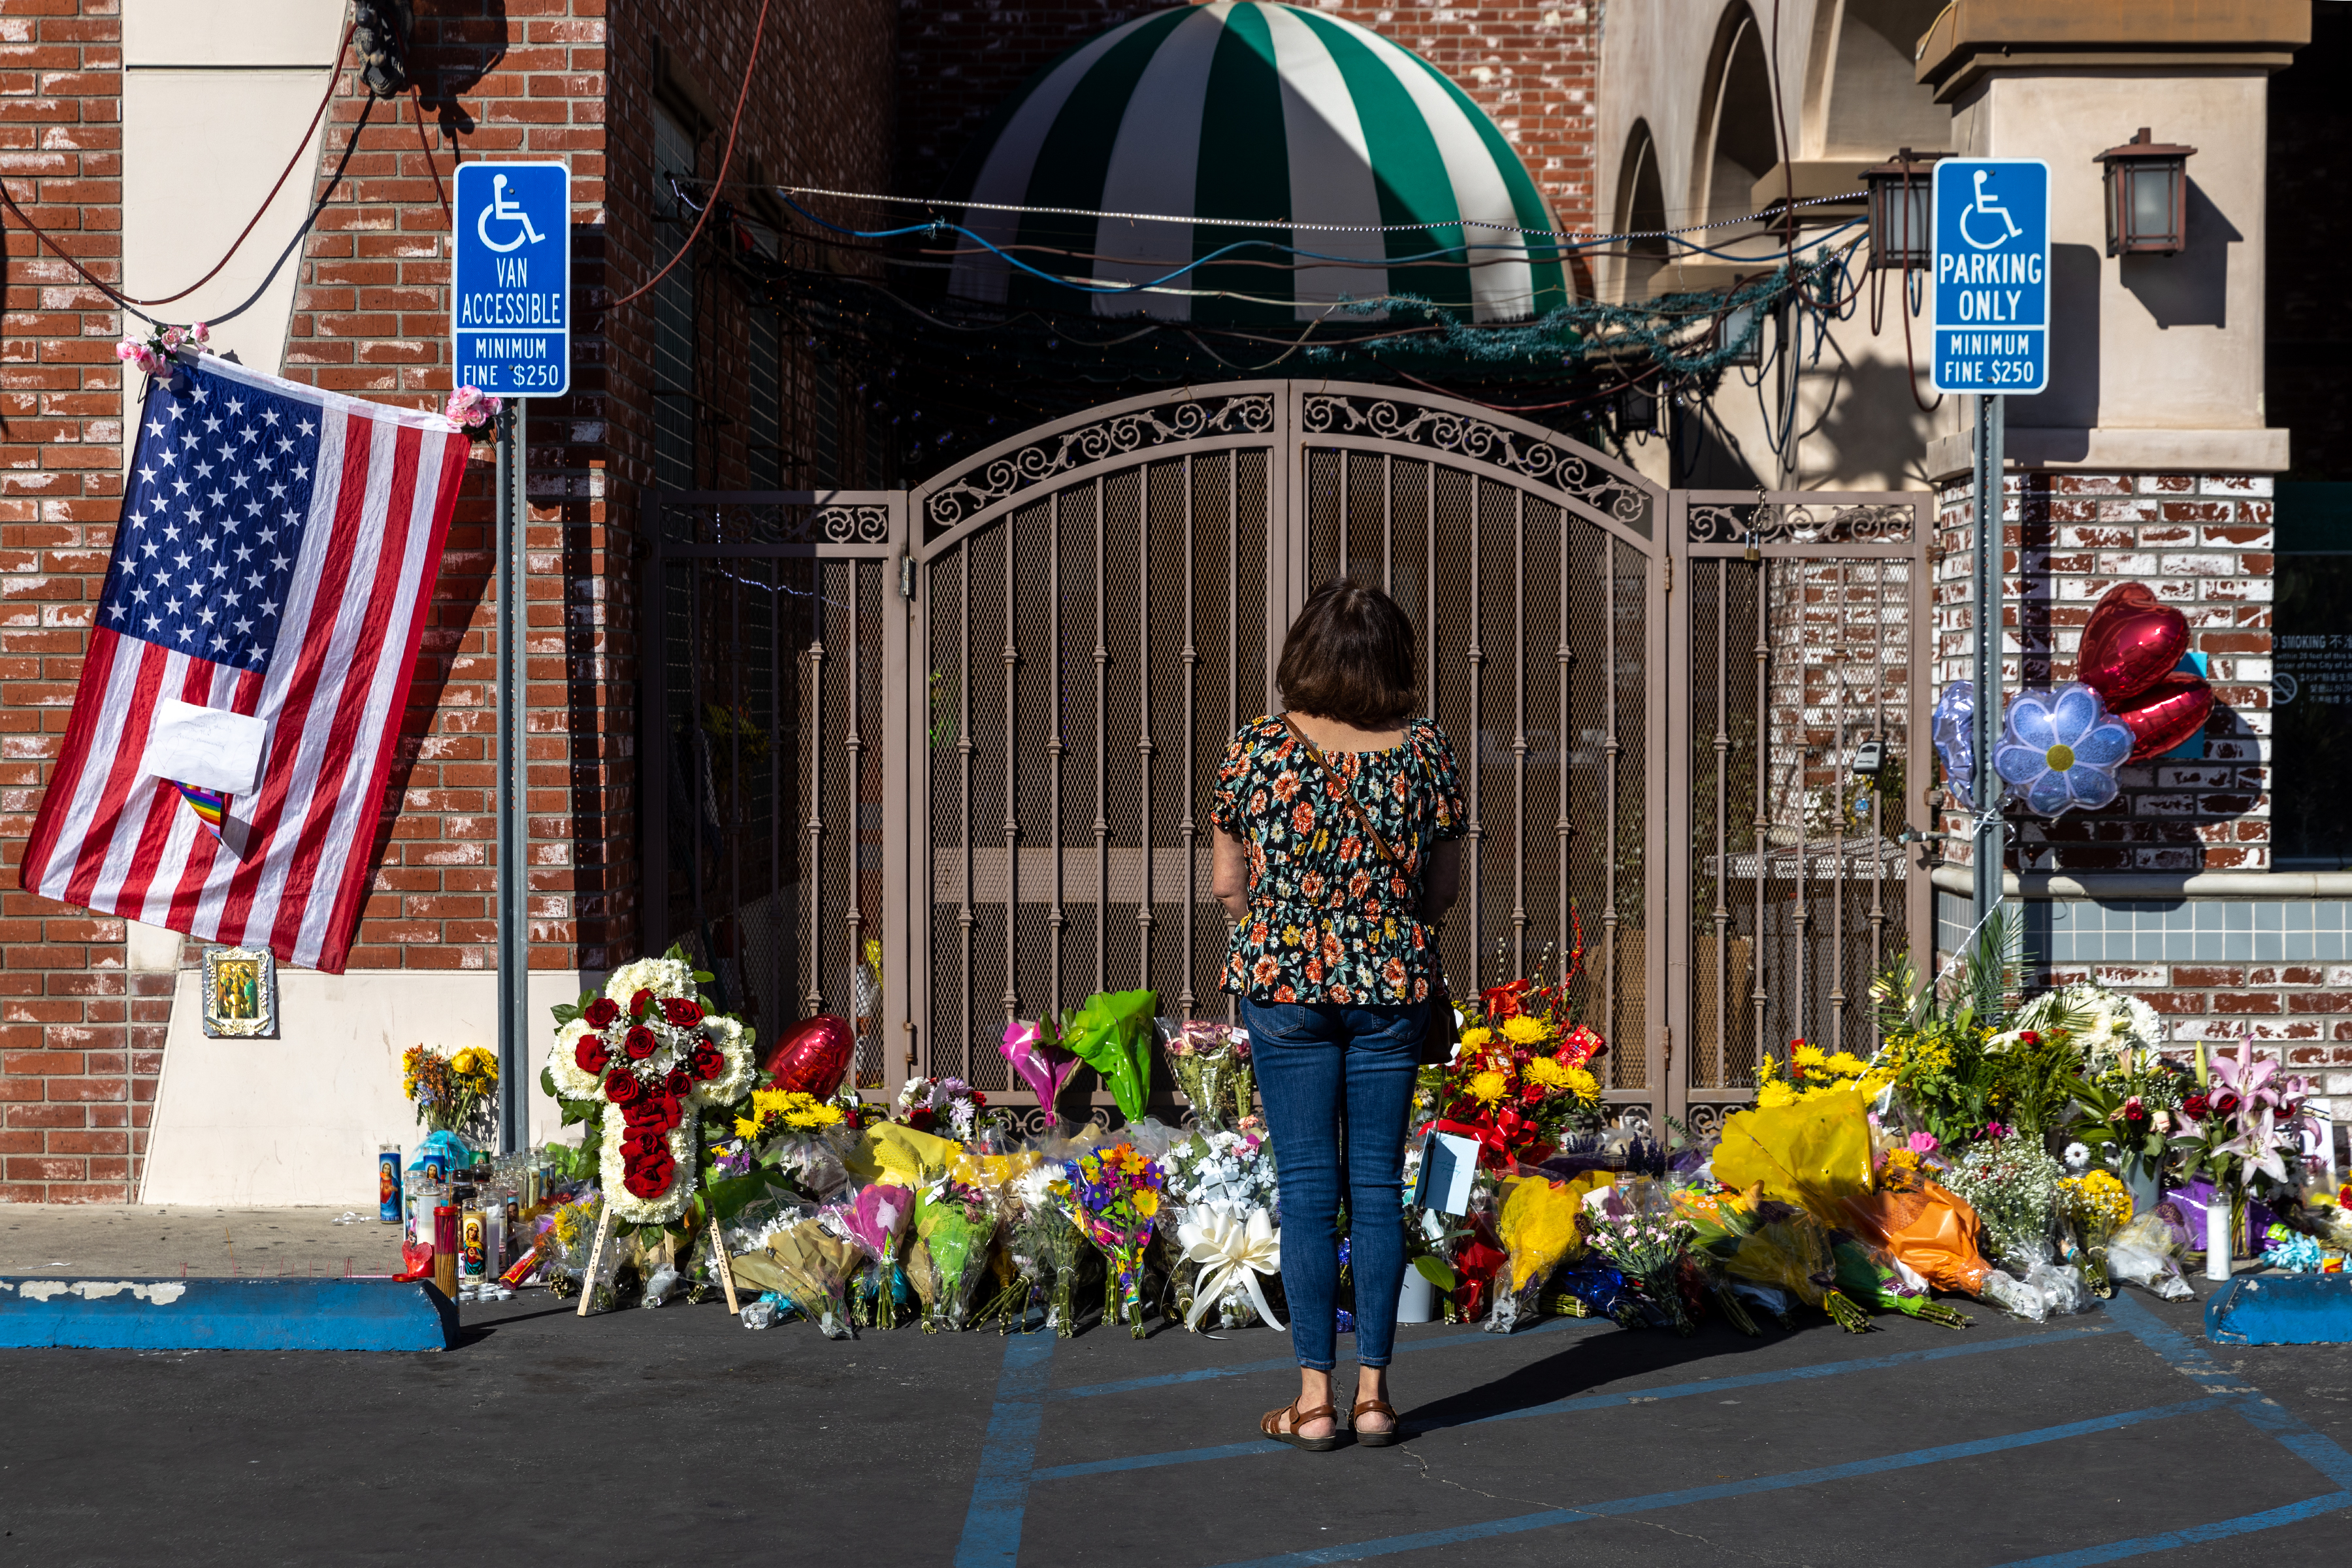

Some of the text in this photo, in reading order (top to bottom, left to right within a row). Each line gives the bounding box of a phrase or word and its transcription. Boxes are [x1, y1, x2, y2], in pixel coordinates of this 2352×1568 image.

[496, 257, 527, 288] VAN
[1940, 253, 2042, 284] PARKING
[462, 293, 561, 324] ACCESSIBLE
[1959, 290, 2022, 321] ONLY
[476, 338, 546, 359] MINIMUM
[1950, 334, 2029, 355] MINIMUM
[463, 363, 559, 388] FINE $250
[1944, 359, 2034, 384] FINE $250
[2272, 634, 2326, 649] O SMOKING
[2319, 661, 2333, 670] City
